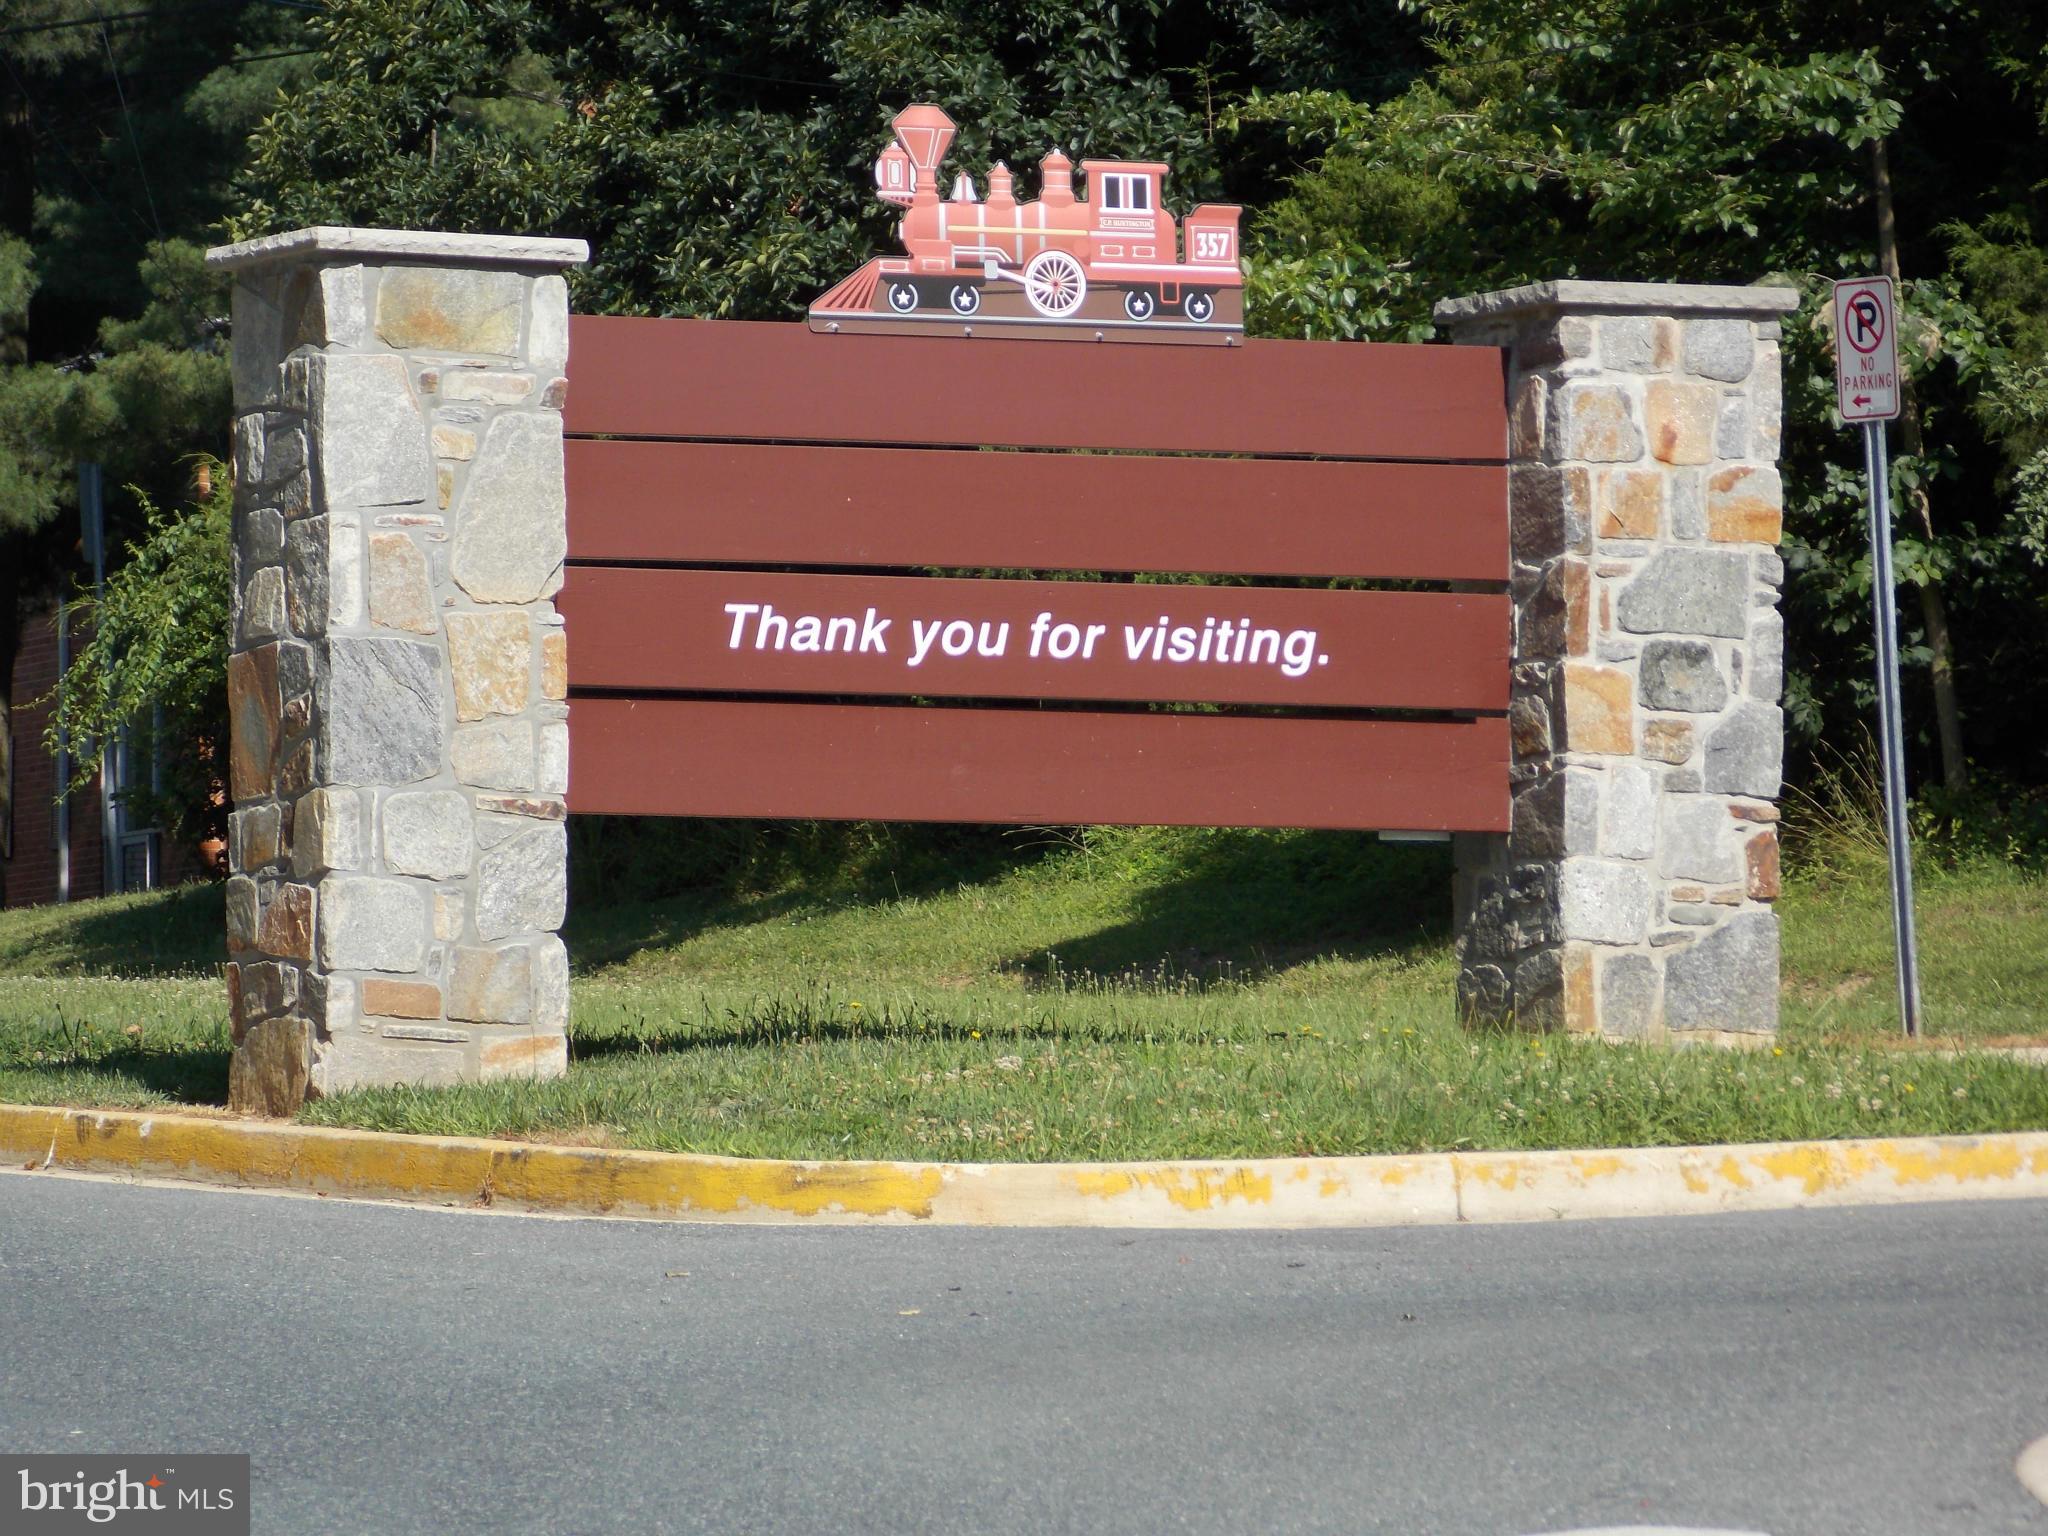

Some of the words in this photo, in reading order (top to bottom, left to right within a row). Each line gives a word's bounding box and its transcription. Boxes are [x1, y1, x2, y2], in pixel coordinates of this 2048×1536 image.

[1196, 232, 1230, 257] 357
[1861, 356, 1875, 372] NO
[1844, 373, 1893, 391] PARKING
[723, 602, 893, 654] Thank
[905, 618, 1011, 667] you
[1028, 611, 1106, 660] for
[1124, 614, 1330, 677] visiting.
